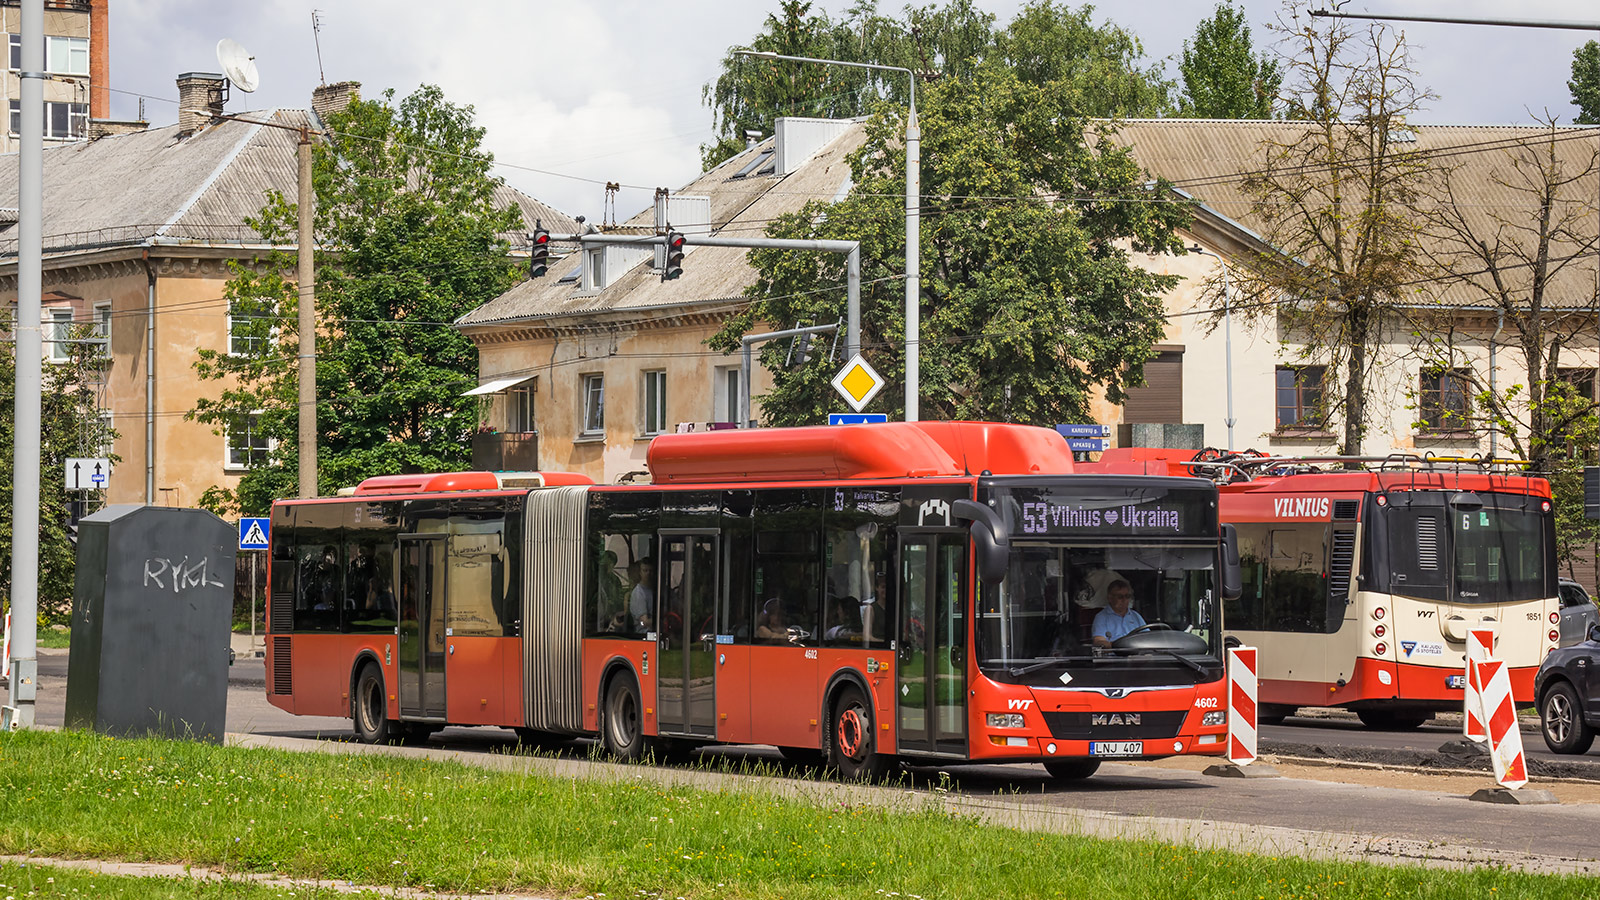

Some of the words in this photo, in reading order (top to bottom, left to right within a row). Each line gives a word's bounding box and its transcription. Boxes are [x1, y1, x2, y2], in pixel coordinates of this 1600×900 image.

[835, 491, 844, 511] 53
[1274, 497, 1329, 517] VILNIUS
[1023, 502, 1047, 533] 53
[1051, 505, 1100, 527] Vilnius
[1122, 505, 1179, 532] Ukrainą
[1463, 514, 1469, 530] 6
[144, 555, 224, 593] RYKL
[1417, 610, 1435, 618] VVT
[805, 650, 817, 659] 4602
[1008, 699, 1034, 710] VVT
[1195, 698, 1218, 708] 4602
[1092, 714, 1141, 725] MAN
[1095, 743, 1118, 754] LNJ
[1123, 743, 1141, 753] 407
